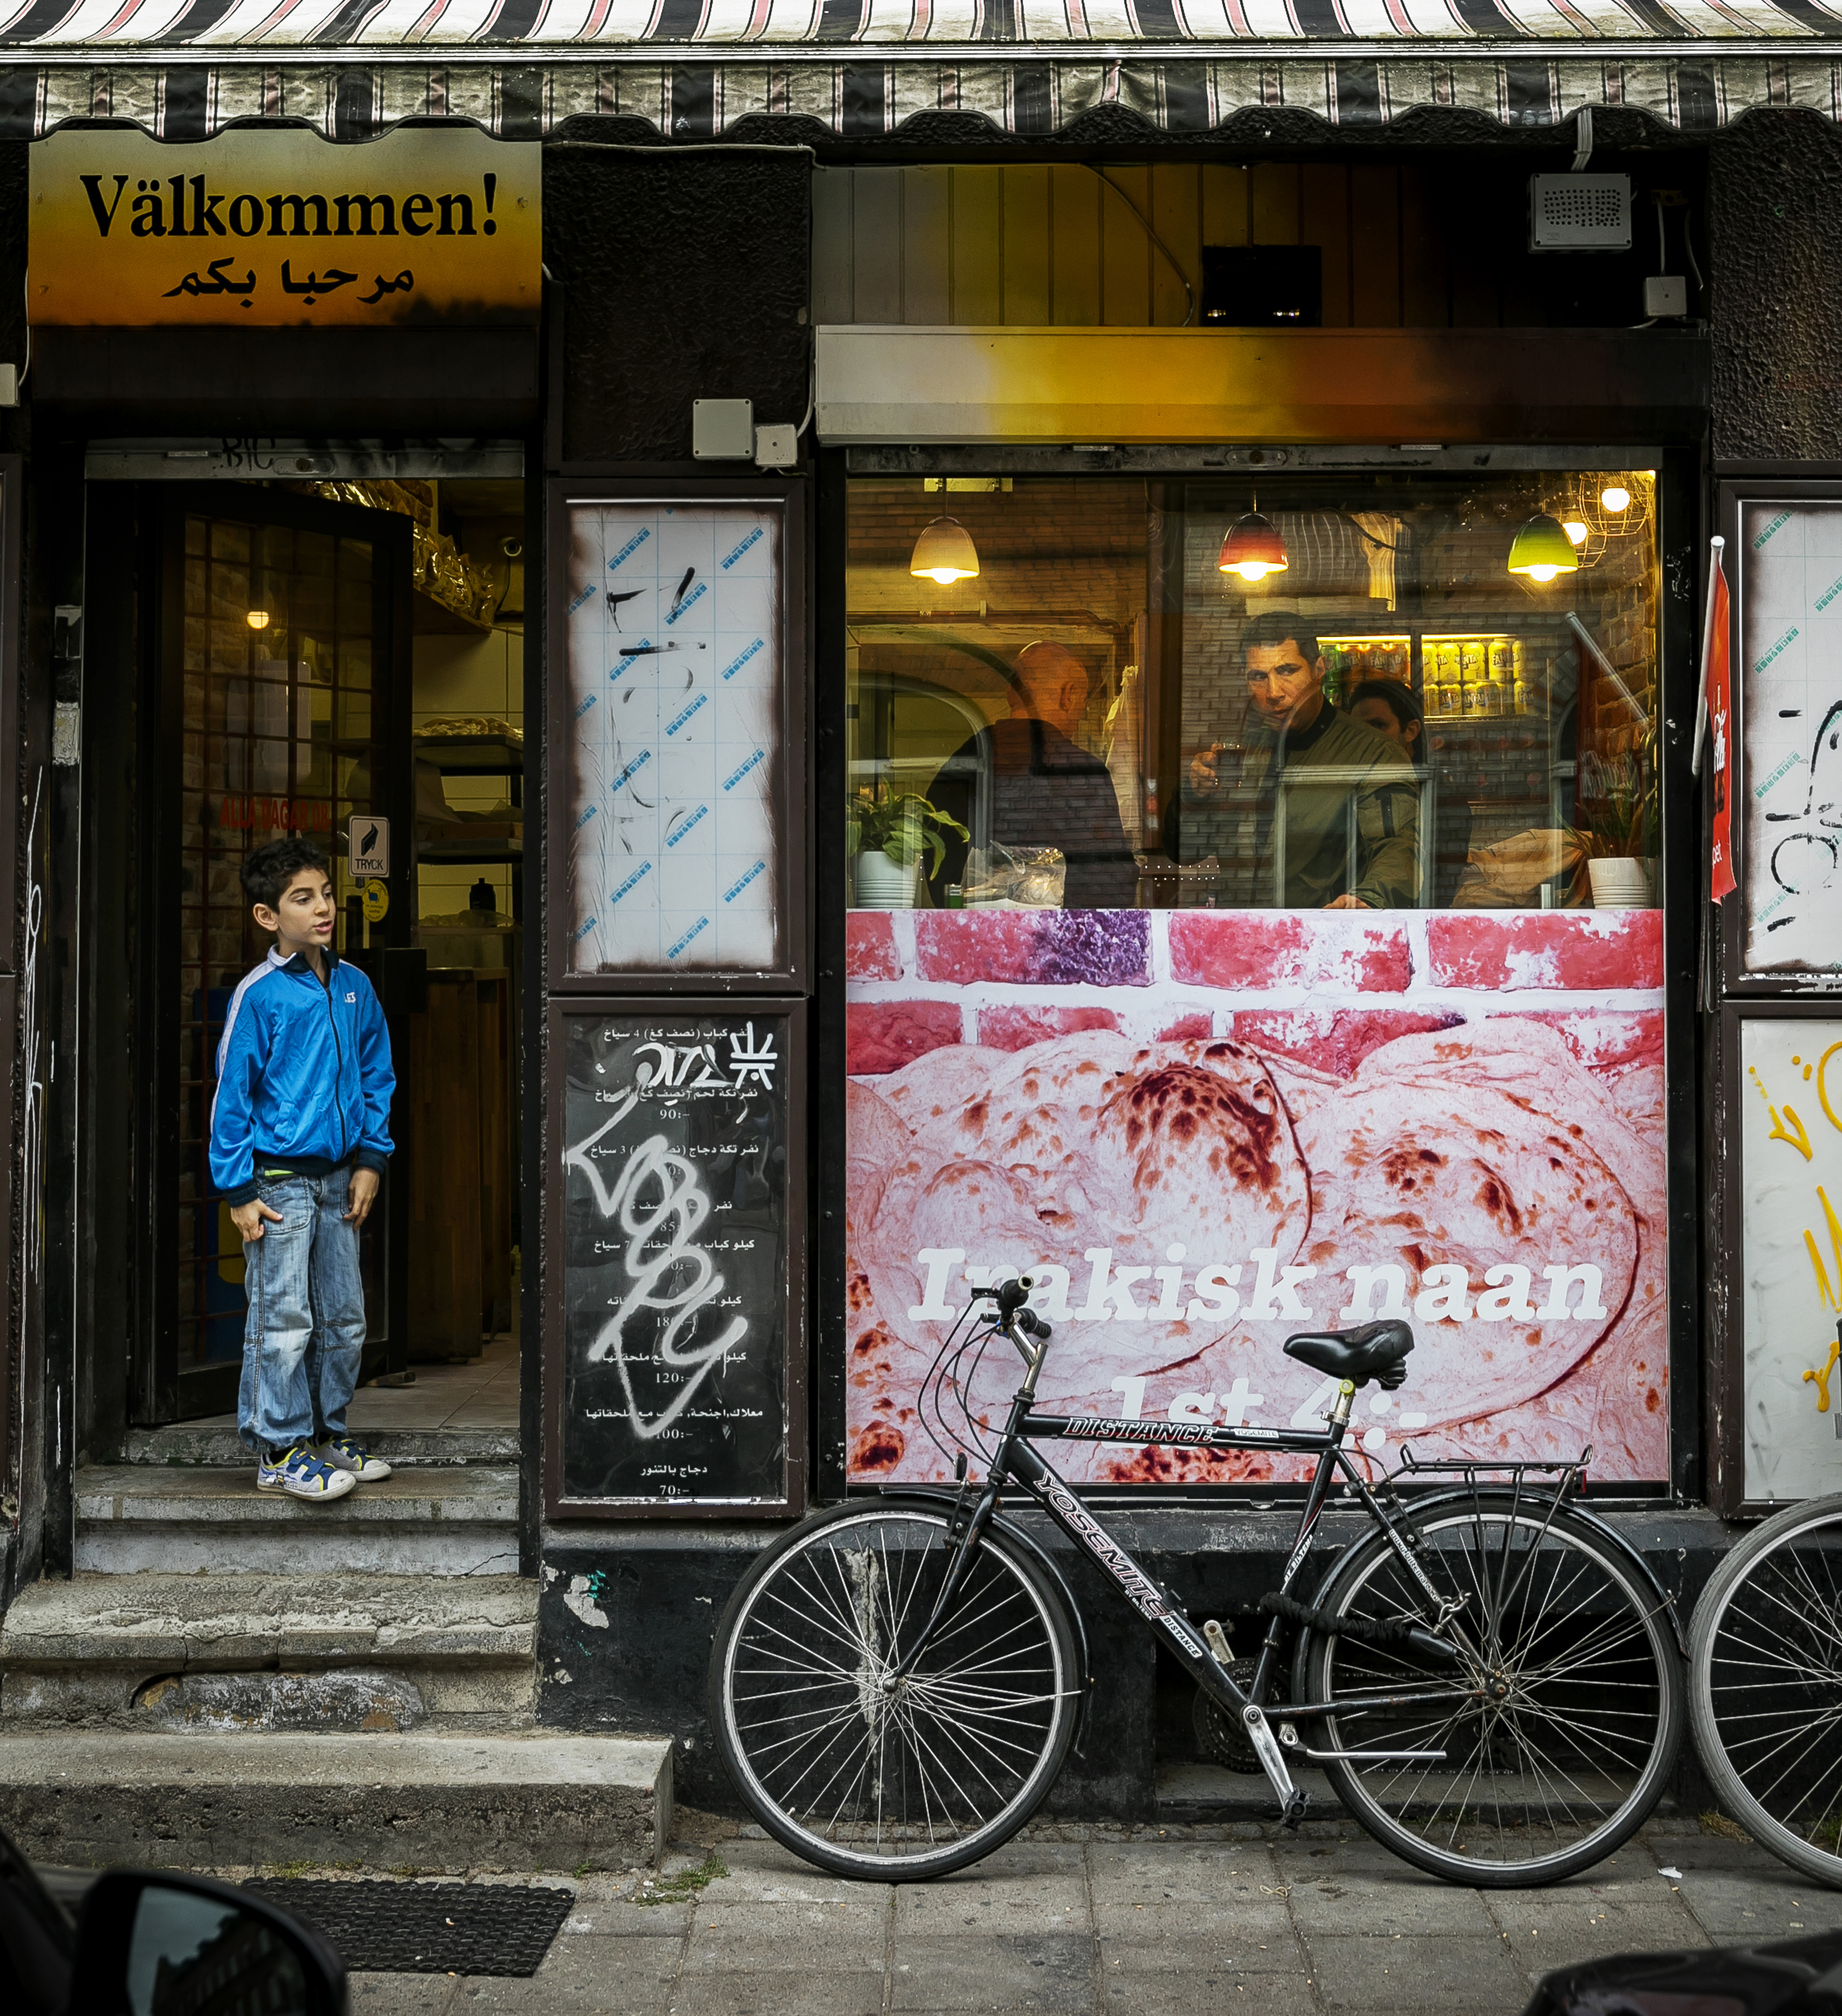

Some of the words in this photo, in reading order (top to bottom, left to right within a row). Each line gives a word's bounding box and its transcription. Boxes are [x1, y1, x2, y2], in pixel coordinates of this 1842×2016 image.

[80, 172, 497, 238] Välkommen!
[161, 257, 257, 309] بكم
[281, 259, 415, 306] مرحبا
[220, 796, 257, 829] ALLA
[262, 799, 308, 831] DAGAR
[355, 858, 384, 870] TRYCK
[633, 1028, 640, 1038] 4
[659, 1109, 690, 1119] 90:-
[590, 1144, 617, 1158] سياخ
[619, 1145, 626, 1154] 3
[689, 1144, 717, 1158] دجاج
[719, 1144, 737, 1154] تكة
[739, 1144, 759, 1156] نفر
[594, 1240, 621, 1252] سياخ
[732, 1239, 755, 1251] كيلو
[908, 1243, 1318, 1321] Irakisk
[1340, 1263, 1608, 1321] naan
[656, 1372, 692, 1383] 120:-
[1063, 1417, 1220, 1444] DISTANCE
[1234, 1429, 1279, 1438] YOSEMITE
[640, 1464, 677, 1476] بالتنور
[679, 1464, 708, 1478] دجاج
[659, 1485, 690, 1495] 70:-
[1034, 1467, 1169, 1619] YOSEMITE
[1290, 1533, 1314, 1572] BILTEMA
[1124, 1588, 1133, 1598] BY
[1131, 1597, 1152, 1622] BILTEMA
[1163, 1616, 1201, 1656] DISTANCE
